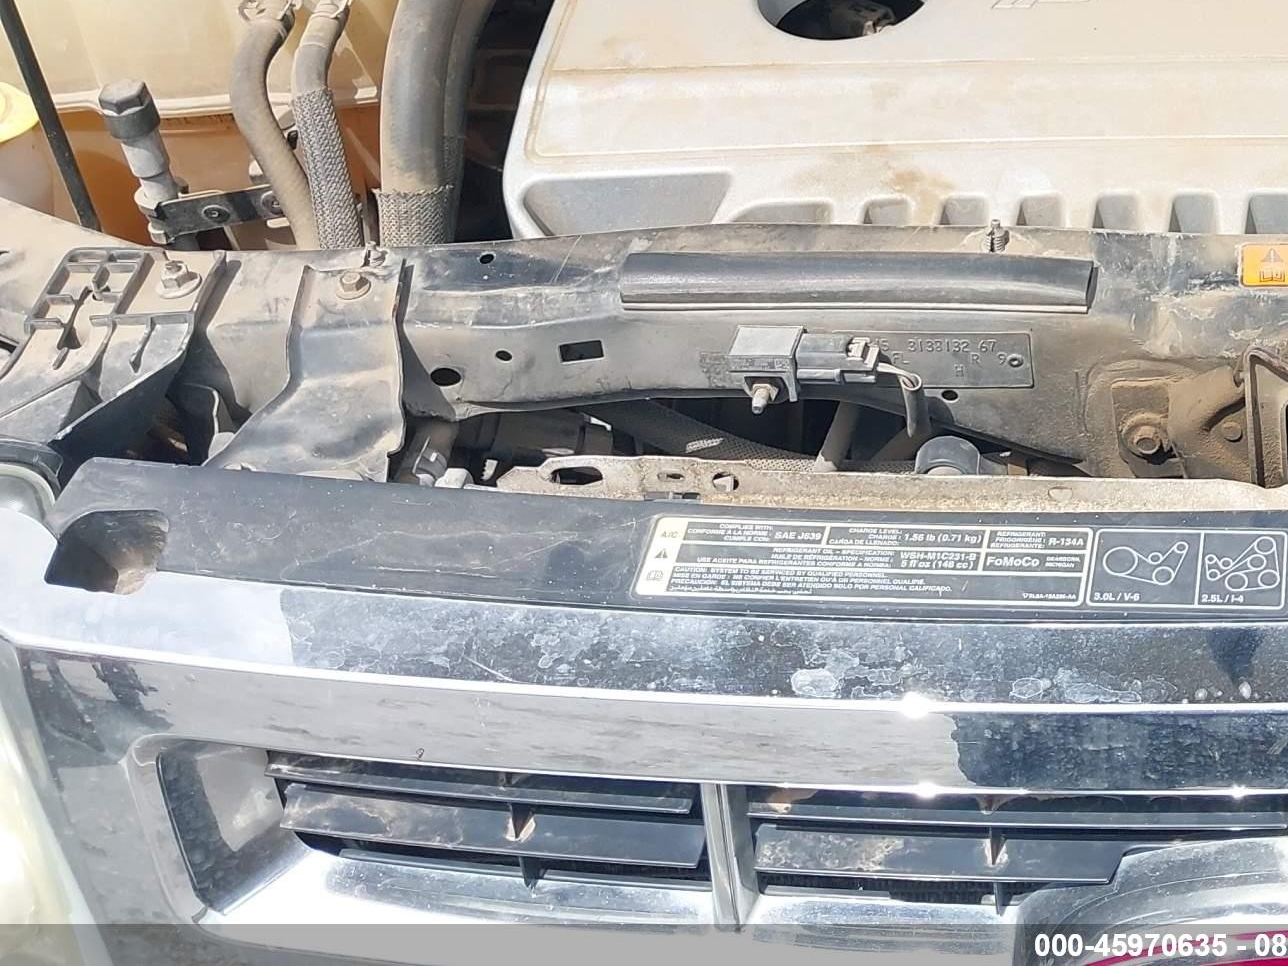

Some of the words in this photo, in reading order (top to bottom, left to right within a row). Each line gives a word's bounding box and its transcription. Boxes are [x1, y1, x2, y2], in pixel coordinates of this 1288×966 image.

[978, 338, 997, 353] 67
[774, 531, 796, 540] SAE
[797, 532, 822, 541] J639
[926, 533, 935, 542] lb
[938, 533, 962, 544] (0.71
[964, 534, 982, 545] kg)
[1048, 537, 1084, 547] R-134A
[900, 560, 908, 569] 5
[955, 561, 973, 570] cc)
[986, 556, 1040, 567] FoMoCo
[1093, 592, 1116, 602] 3.0L
[1123, 593, 1141, 603] V-6
[1201, 594, 1223, 604] 2.5L
[1230, 595, 1244, 605] I-4
